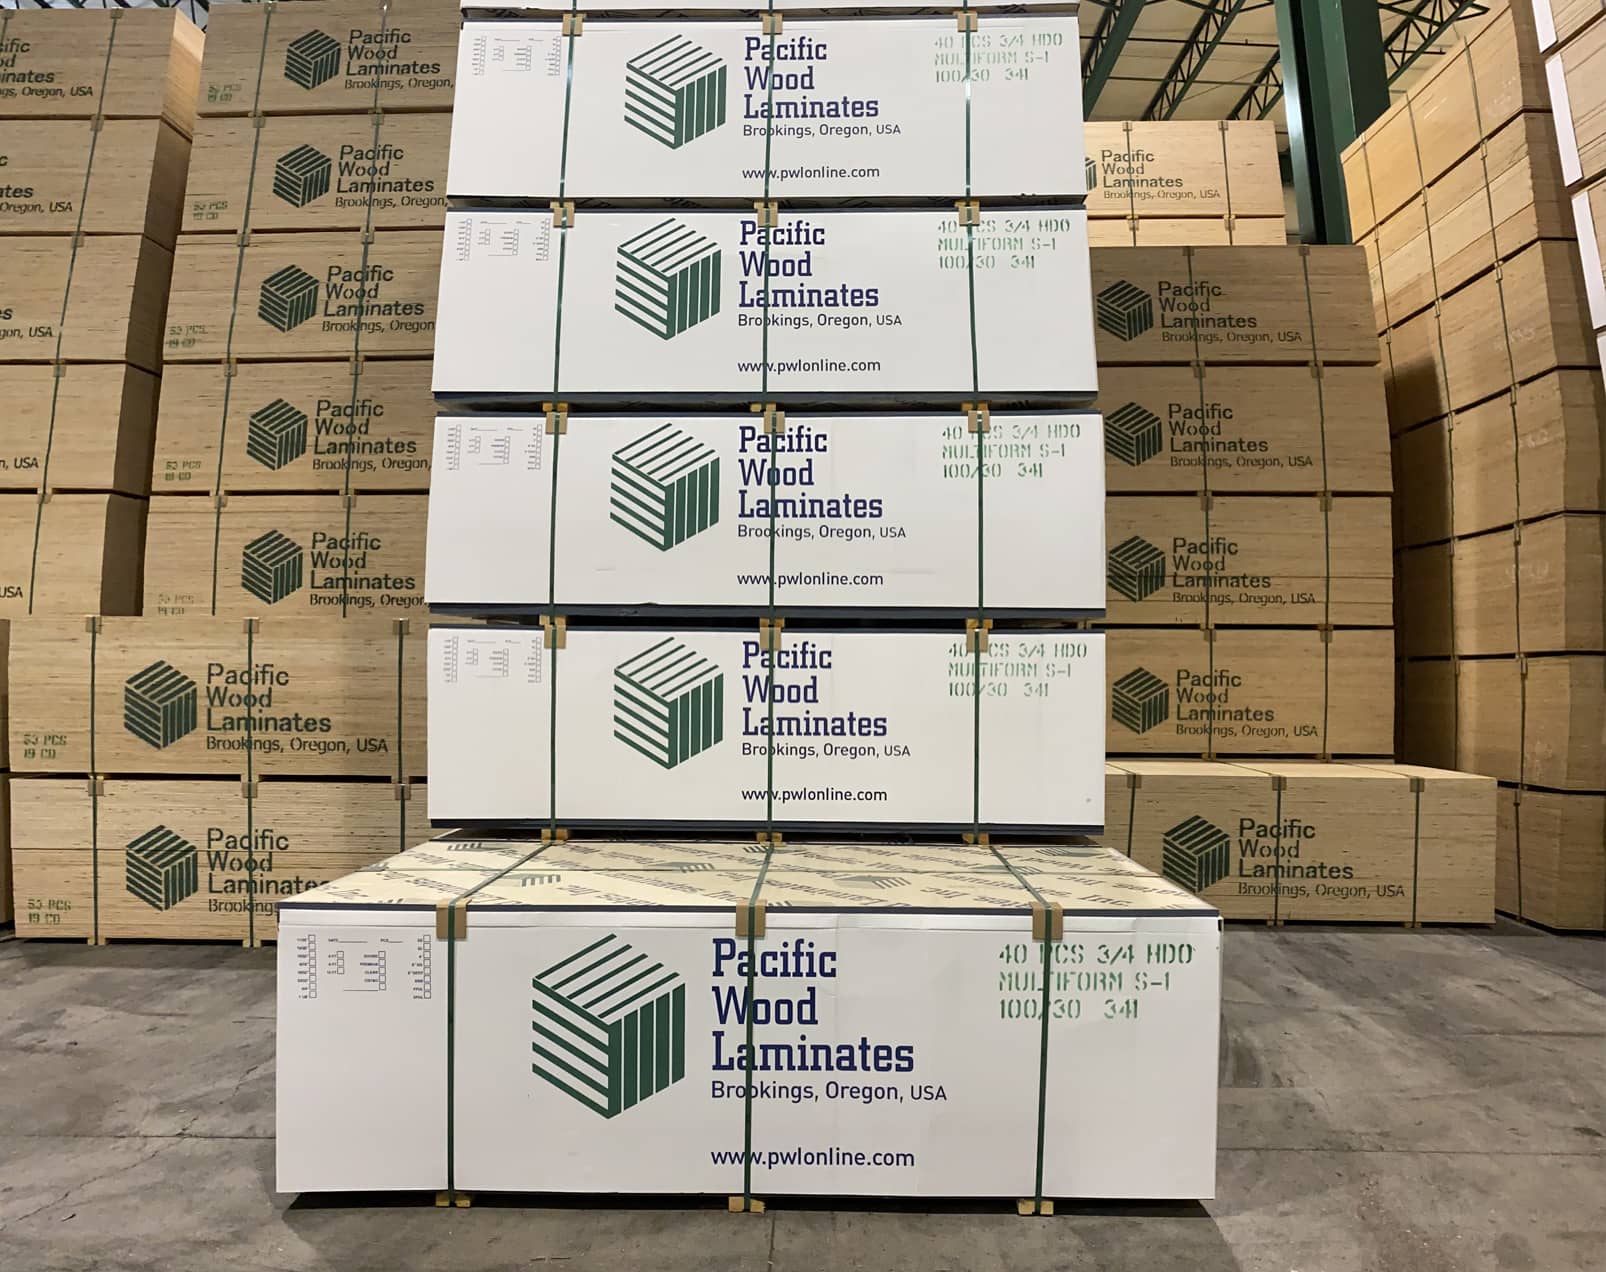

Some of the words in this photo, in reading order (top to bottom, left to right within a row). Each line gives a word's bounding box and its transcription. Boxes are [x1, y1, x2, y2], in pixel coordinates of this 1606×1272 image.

[350, 29, 411, 44] Pacific
[934, 35, 953, 49] 40
[1000, 34, 1024, 47] 3/4
[1033, 33, 1063, 47] HDO
[348, 46, 397, 60] Wood
[745, 37, 827, 61] Pacific
[935, 51, 1017, 66] MULIFORM
[1025, 51, 1049, 64] S-1
[346, 61, 440, 76] Laminates
[1005, 68, 1028, 82] 341
[408, 78, 454, 89] Oregon,
[744, 66, 815, 90] Wood
[22, 87, 65, 98] Oregon,
[70, 86, 93, 96] USA
[744, 94, 879, 119] Laminates
[743, 124, 815, 138] Brookings,
[819, 124, 872, 138] Oregon,
[876, 124, 901, 134] USA
[340, 145, 404, 160] Pacific
[1101, 150, 1154, 162] Pacific
[338, 162, 390, 176] Wood
[742, 166, 880, 181] www.pwlonline.com
[1101, 163, 1144, 175] Wood
[337, 178, 434, 193] Laminates
[1103, 176, 1183, 188] Laminates
[401, 196, 448, 208] Oregon,
[1158, 190, 1196, 200] Oregon,
[1200, 190, 1220, 198] USA
[0, 202, 44, 214] Oregon,
[50, 202, 72, 212] USA
[740, 221, 825, 246] Pacific
[938, 221, 957, 234] 40
[1005, 219, 1030, 233] 3/4
[1039, 219, 1070, 233] HDO
[1031, 237, 1056, 251] S-1
[739, 251, 812, 277] Wood
[1010, 255, 1034, 268] 341
[327, 265, 394, 281] Pacific
[326, 284, 378, 299] Wood
[739, 281, 879, 308] Laminates
[1158, 281, 1222, 296] Pacific
[324, 300, 424, 317] Laminates
[1160, 298, 1210, 312] Wood
[739, 314, 813, 329] Brookings,
[818, 314, 872, 330] Oregon,
[876, 315, 902, 326] USA
[1161, 314, 1257, 329] Laminates
[29, 326, 52, 337] USA
[1162, 332, 1223, 343] Brookngs,
[1227, 332, 1273, 344] Oregon,
[1278, 332, 1302, 342] USA
[738, 359, 881, 375] www.pwlonline.com
[316, 400, 384, 416] Pacific
[1169, 403, 1232, 419] Pacific
[314, 418, 369, 434] Wood
[942, 427, 962, 440] 40
[1012, 424, 1038, 438] 3/4
[1048, 424, 1080, 438] HDO
[1169, 420, 1221, 436] Wood
[313, 437, 416, 454] Laminates
[739, 426, 827, 453] Pacific
[1170, 438, 1268, 452] Laminates
[1040, 444, 1065, 457] S-1
[14, 458, 38, 469] USA
[313, 458, 376, 471] Brookngs,
[382, 458, 431, 472] Oregon,
[1170, 456, 1232, 468] Brookngs,
[1237, 456, 1284, 469] Oregon,
[1288, 456, 1313, 466] USA
[739, 458, 814, 486] Wood
[944, 463, 1001, 479] 100/30
[1017, 463, 1042, 477] 341
[739, 489, 883, 518] Laminates
[738, 524, 815, 540] Brookings,
[820, 525, 875, 541] Oregon,
[880, 526, 906, 538] USA
[312, 532, 381, 550] Pacific
[1173, 537, 1238, 555] Pacific
[311, 551, 366, 568] Wood
[1173, 556, 1225, 572] Wood
[310, 570, 415, 590] Laminates
[737, 572, 883, 588] www.pwlonline.com
[1172, 572, 1271, 588] Laminates
[1239, 592, 1286, 606] Oregon,
[1291, 593, 1315, 604] USA
[743, 641, 832, 669] Pacific
[948, 643, 968, 657] 40
[1019, 643, 1045, 657] 3/4
[1055, 643, 1087, 657] HDO
[207, 663, 289, 685] Pacific
[1046, 664, 1071, 677] S-1
[1176, 669, 1242, 687] Pacific
[207, 686, 272, 708] Wood
[743, 676, 818, 703] Wood
[1024, 682, 1048, 696] 341
[1176, 688, 1228, 703] Wood
[207, 709, 331, 732] Laminates
[1176, 705, 1274, 721] Laminates
[742, 708, 887, 736] Laminates
[1176, 725, 1236, 737] Brookngs,
[1242, 726, 1288, 738] Oregon,
[1294, 726, 1318, 736] USA
[207, 736, 285, 754] Brookngs,
[290, 736, 350, 754] Oregon,
[357, 738, 388, 753] USA
[742, 743, 819, 759] Brookings,
[824, 744, 879, 759] Oregon,
[884, 745, 910, 757] USA
[742, 788, 887, 803] www.pwlonline.com
[1239, 818, 1315, 838] Pacific
[207, 828, 289, 850] Pacific
[1239, 839, 1299, 858] Wood
[207, 852, 272, 872] Wood
[1239, 859, 1354, 879] Laminates
[1316, 883, 1370, 898] Oregon,
[1377, 884, 1404, 898] USA
[712, 938, 837, 978] Pacific
[1000, 944, 1027, 965] 40
[1098, 944, 1134, 965] 3/4
[1147, 944, 1193, 965] HDO
[1135, 972, 1170, 991] S-1
[712, 986, 818, 1025] Wood
[1104, 999, 1138, 1019] 341
[712, 1031, 914, 1072] Laminates
[712, 1081, 819, 1102] Brookings,
[825, 1082, 903, 1103] Oregon,
[910, 1085, 947, 1101] USA
[711, 1147, 914, 1170] www.pwlonline.com
